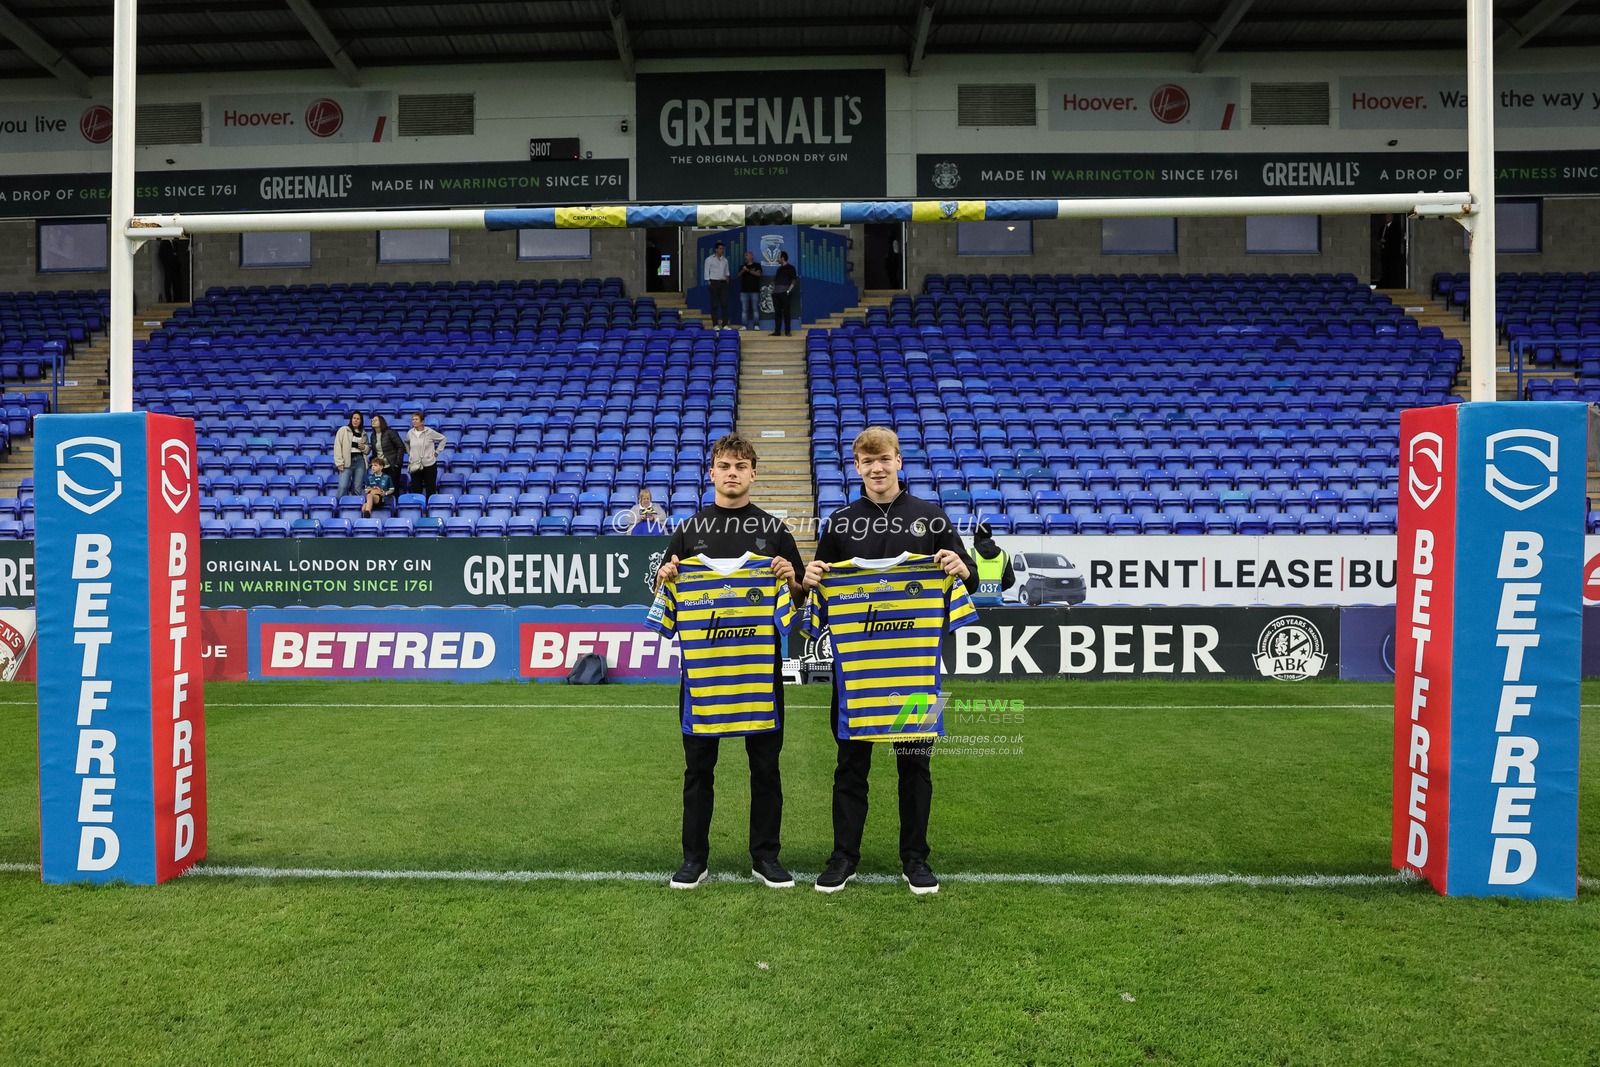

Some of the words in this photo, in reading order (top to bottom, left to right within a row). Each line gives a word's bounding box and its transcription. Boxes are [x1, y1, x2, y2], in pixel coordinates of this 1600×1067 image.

[1063, 94, 1137, 111] Hoover.
[1352, 92, 1427, 110] Hoover.
[1439, 91, 1469, 108] Wa
[1500, 89, 1535, 108] the
[1542, 91, 1584, 110] way
[35, 115, 67, 132] live
[224, 110, 294, 127] Hoover.
[659, 95, 863, 147] GREENALL'S
[530, 142, 551, 157] SHOT
[671, 155, 692, 164] THE
[696, 154, 748, 163] ORIGINAL
[752, 153, 800, 163] LONDON
[804, 153, 826, 162] DRY
[828, 153, 848, 162] GIN
[733, 167, 765, 176] SINCE
[768, 167, 788, 175] 1761
[981, 170, 1025, 181] MADE
[1031, 170, 1046, 181] IN
[1051, 169, 1156, 181] WARRINGTON
[1161, 169, 1205, 181] SINCE
[1211, 169, 1238, 181] 1761
[1379, 169, 1389, 180] A
[1396, 169, 1437, 180] DROP
[1443, 168, 1463, 180] OF
[1563, 167, 1600, 178] SINC
[371, 179, 414, 191] MADE
[419, 179, 434, 190] IN
[439, 176, 540, 190] WARRINGTON
[546, 175, 589, 187] SINCE
[595, 175, 622, 186] 1761
[13, 190, 51, 201] DROP
[56, 189, 74, 200] OF
[164, 185, 205, 197] SINCE
[211, 184, 237, 196] 1761
[206, 560, 282, 572] ORIGINAL
[289, 559, 359, 572] LONDON
[366, 559, 398, 572] DRY
[403, 559, 432, 572] GIN
[463, 552, 630, 595] GREENALL'S
[1090, 559, 1198, 589] RENT
[1214, 559, 1333, 589] LEASE
[1349, 559, 1398, 589] BU
[218, 580, 235, 592] IN
[240, 580, 347, 592] WARRINGTON
[353, 580, 399, 592] SINCE
[404, 580, 433, 592] 1761
[980, 583, 999, 593] 037
[684, 597, 714, 607] Resulting
[839, 592, 870, 601] Resulting
[1272, 620, 1286, 630] 700
[1286, 619, 1306, 628] YEARS
[270, 631, 496, 669] BETFRED
[940, 625, 1044, 674] BK
[1058, 625, 1226, 674] BEER
[1274, 658, 1308, 672] ABK
[71, 533, 121, 872] BETFRED
[168, 532, 195, 862] BETFRED
[1406, 529, 1435, 868] BETFRED
[1488, 530, 1544, 885] BETFRED
